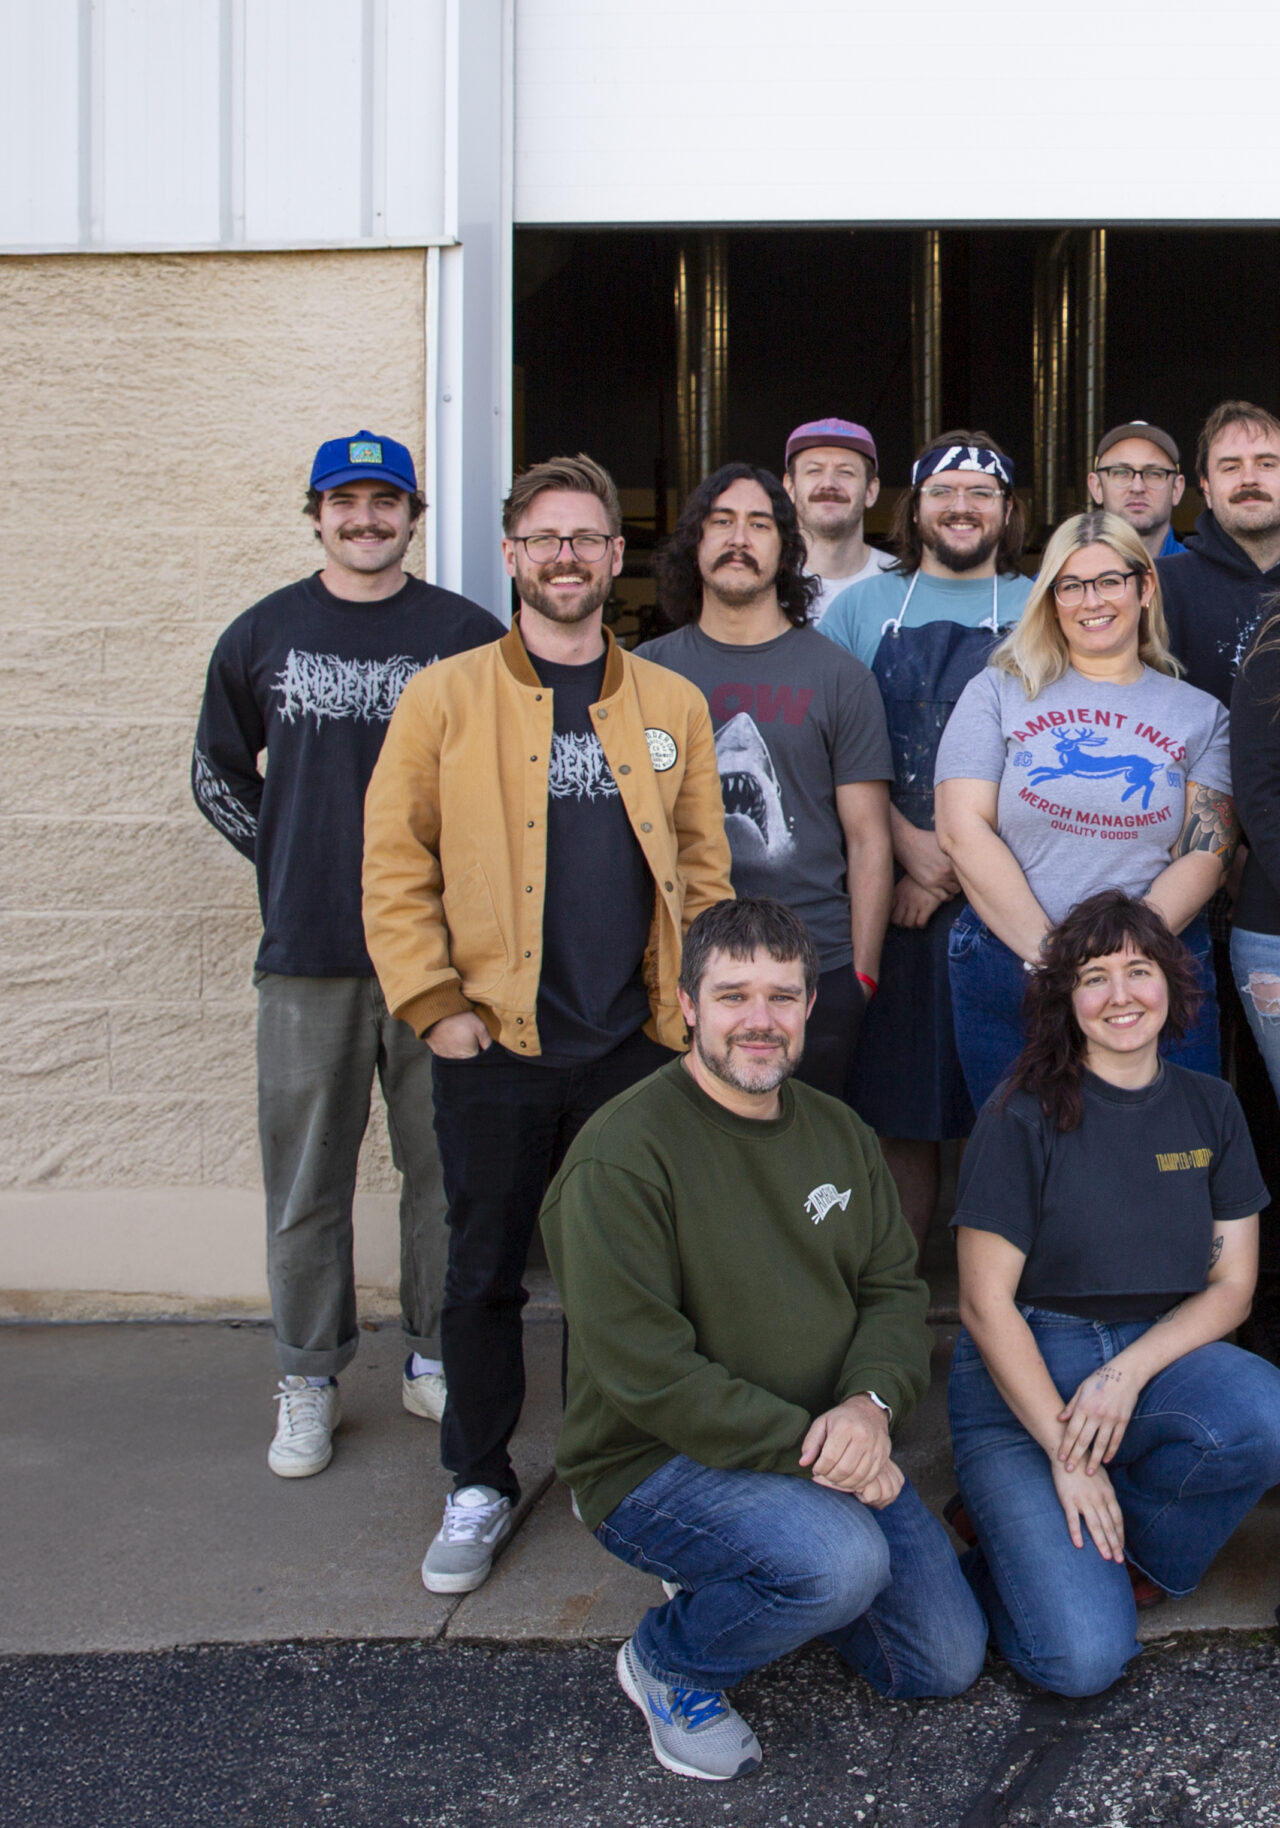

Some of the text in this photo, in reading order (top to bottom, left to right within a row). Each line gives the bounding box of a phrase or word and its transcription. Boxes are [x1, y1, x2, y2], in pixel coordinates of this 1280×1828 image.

[1012, 708, 1187, 762] AMBIENT INKS
[1018, 786, 1173, 828] MERCH MANAGMENT
[1050, 819, 1139, 841] QUALITY GOODS
